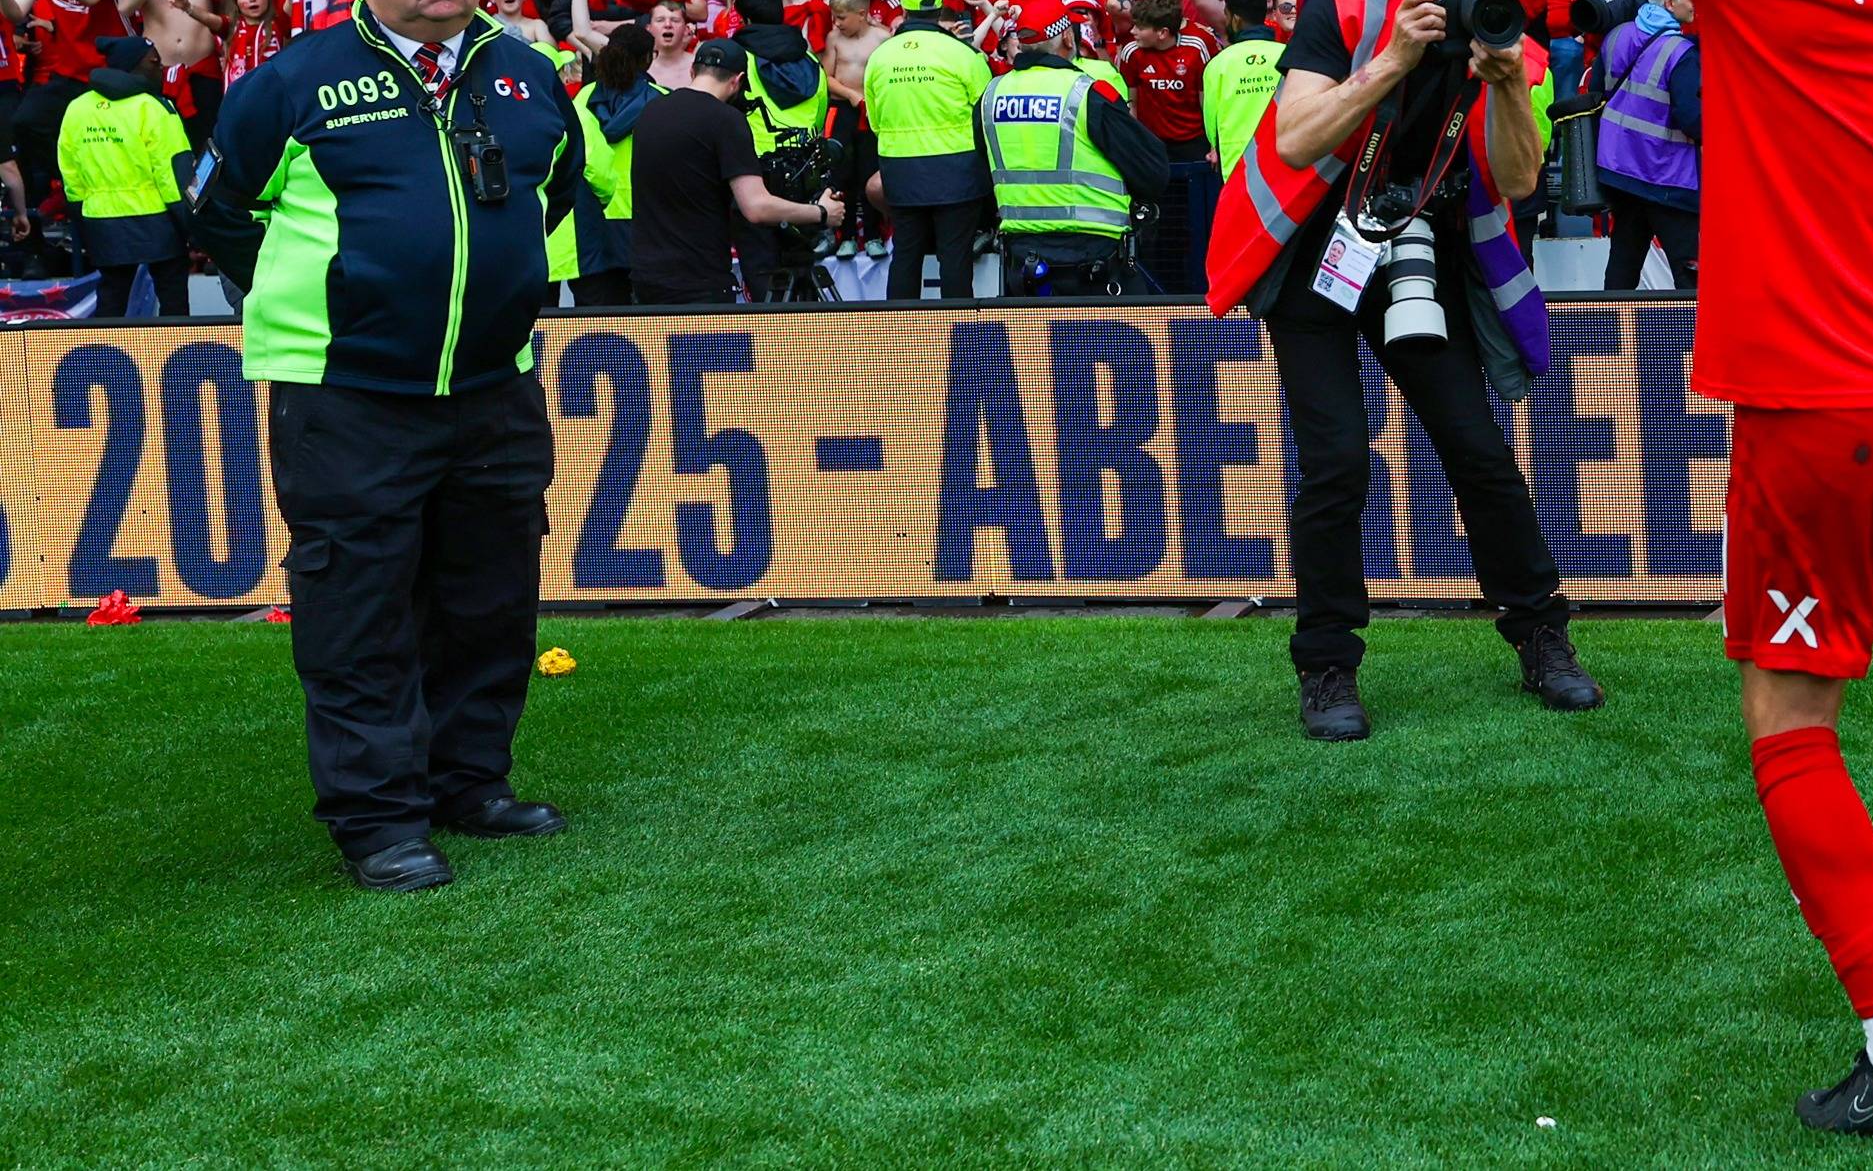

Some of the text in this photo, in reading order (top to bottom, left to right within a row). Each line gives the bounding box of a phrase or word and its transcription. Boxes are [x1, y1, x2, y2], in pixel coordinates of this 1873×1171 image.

[893, 65, 926, 73] Here to
[888, 75, 935, 85] assist you
[1150, 78, 1185, 91] TEXO
[1240, 76, 1261, 85] Here
[317, 70, 401, 111] 0093
[1235, 84, 1277, 95] assist yo
[995, 96, 1060, 121] POLICE
[325, 107, 409, 131] SUPERVISOR
[1447, 111, 1464, 139] EOS
[86, 126, 117, 134] Here to
[1360, 132, 1381, 173] Canon
[933, 307, 1732, 582] ABERDEE
